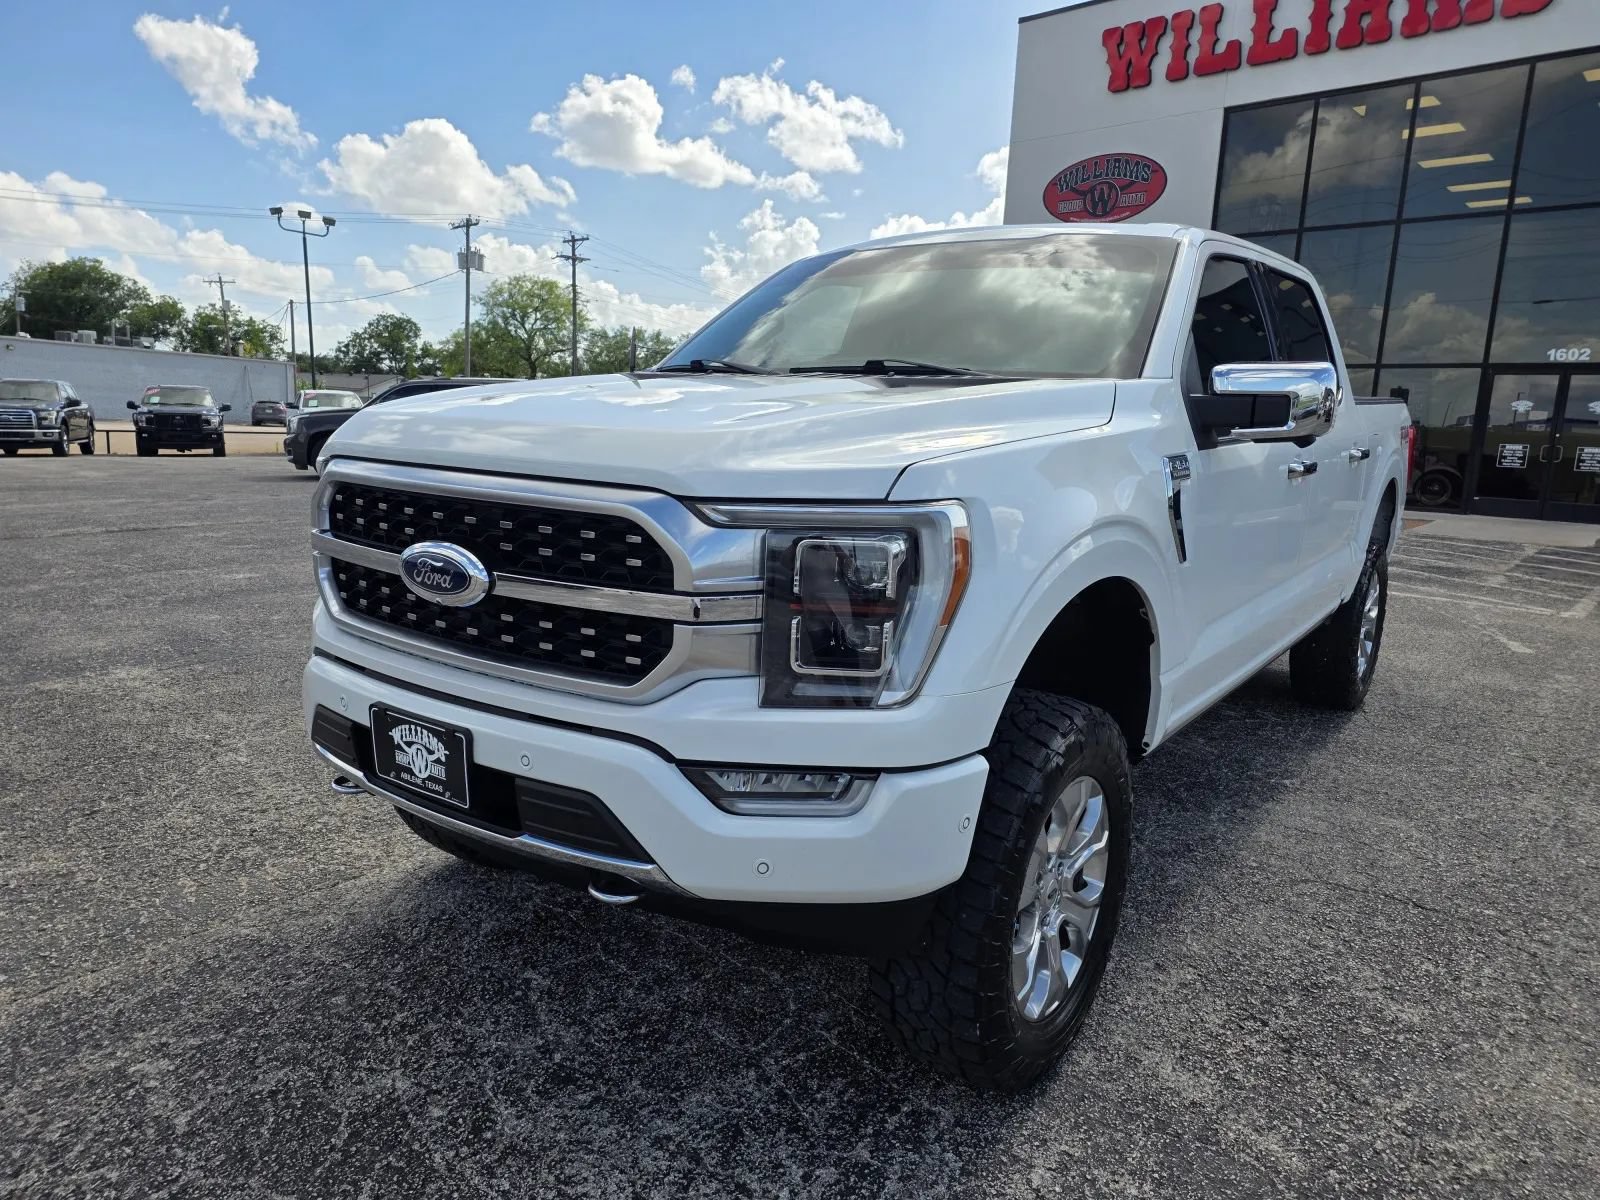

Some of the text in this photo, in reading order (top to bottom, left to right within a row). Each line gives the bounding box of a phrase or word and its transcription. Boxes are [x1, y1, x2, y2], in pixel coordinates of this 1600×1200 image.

[1102, 0, 1553, 93] WILLIA
[1057, 156, 1152, 194] WILLIAMS
[1547, 348, 1591, 361] 1602
[414, 558, 453, 588] Ford
[391, 724, 446, 762] WILLIAMS
[401, 772, 443, 792] ABILENE, TEXAS
